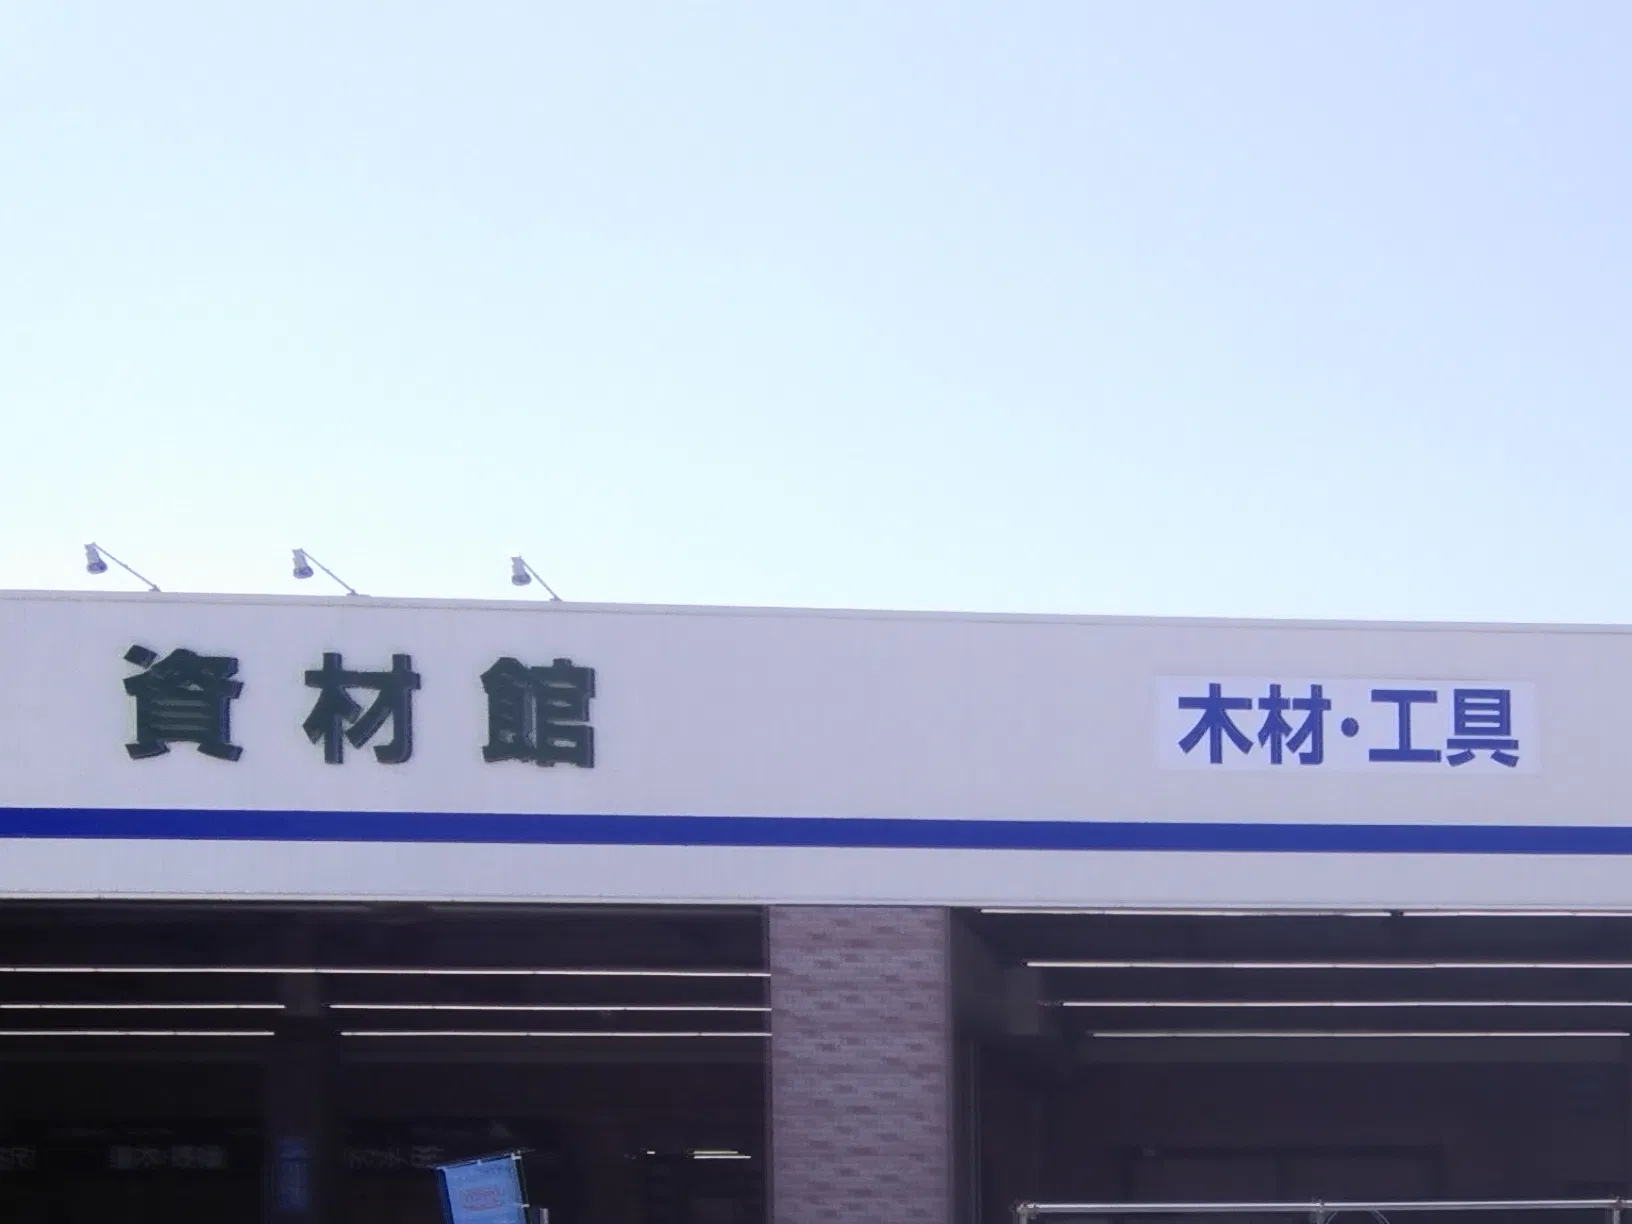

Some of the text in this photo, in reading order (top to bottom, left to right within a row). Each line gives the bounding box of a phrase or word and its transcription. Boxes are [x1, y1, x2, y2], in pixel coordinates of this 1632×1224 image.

[121, 644, 597, 769] 資材館
[1177, 682, 1520, 768] 木材・工具
